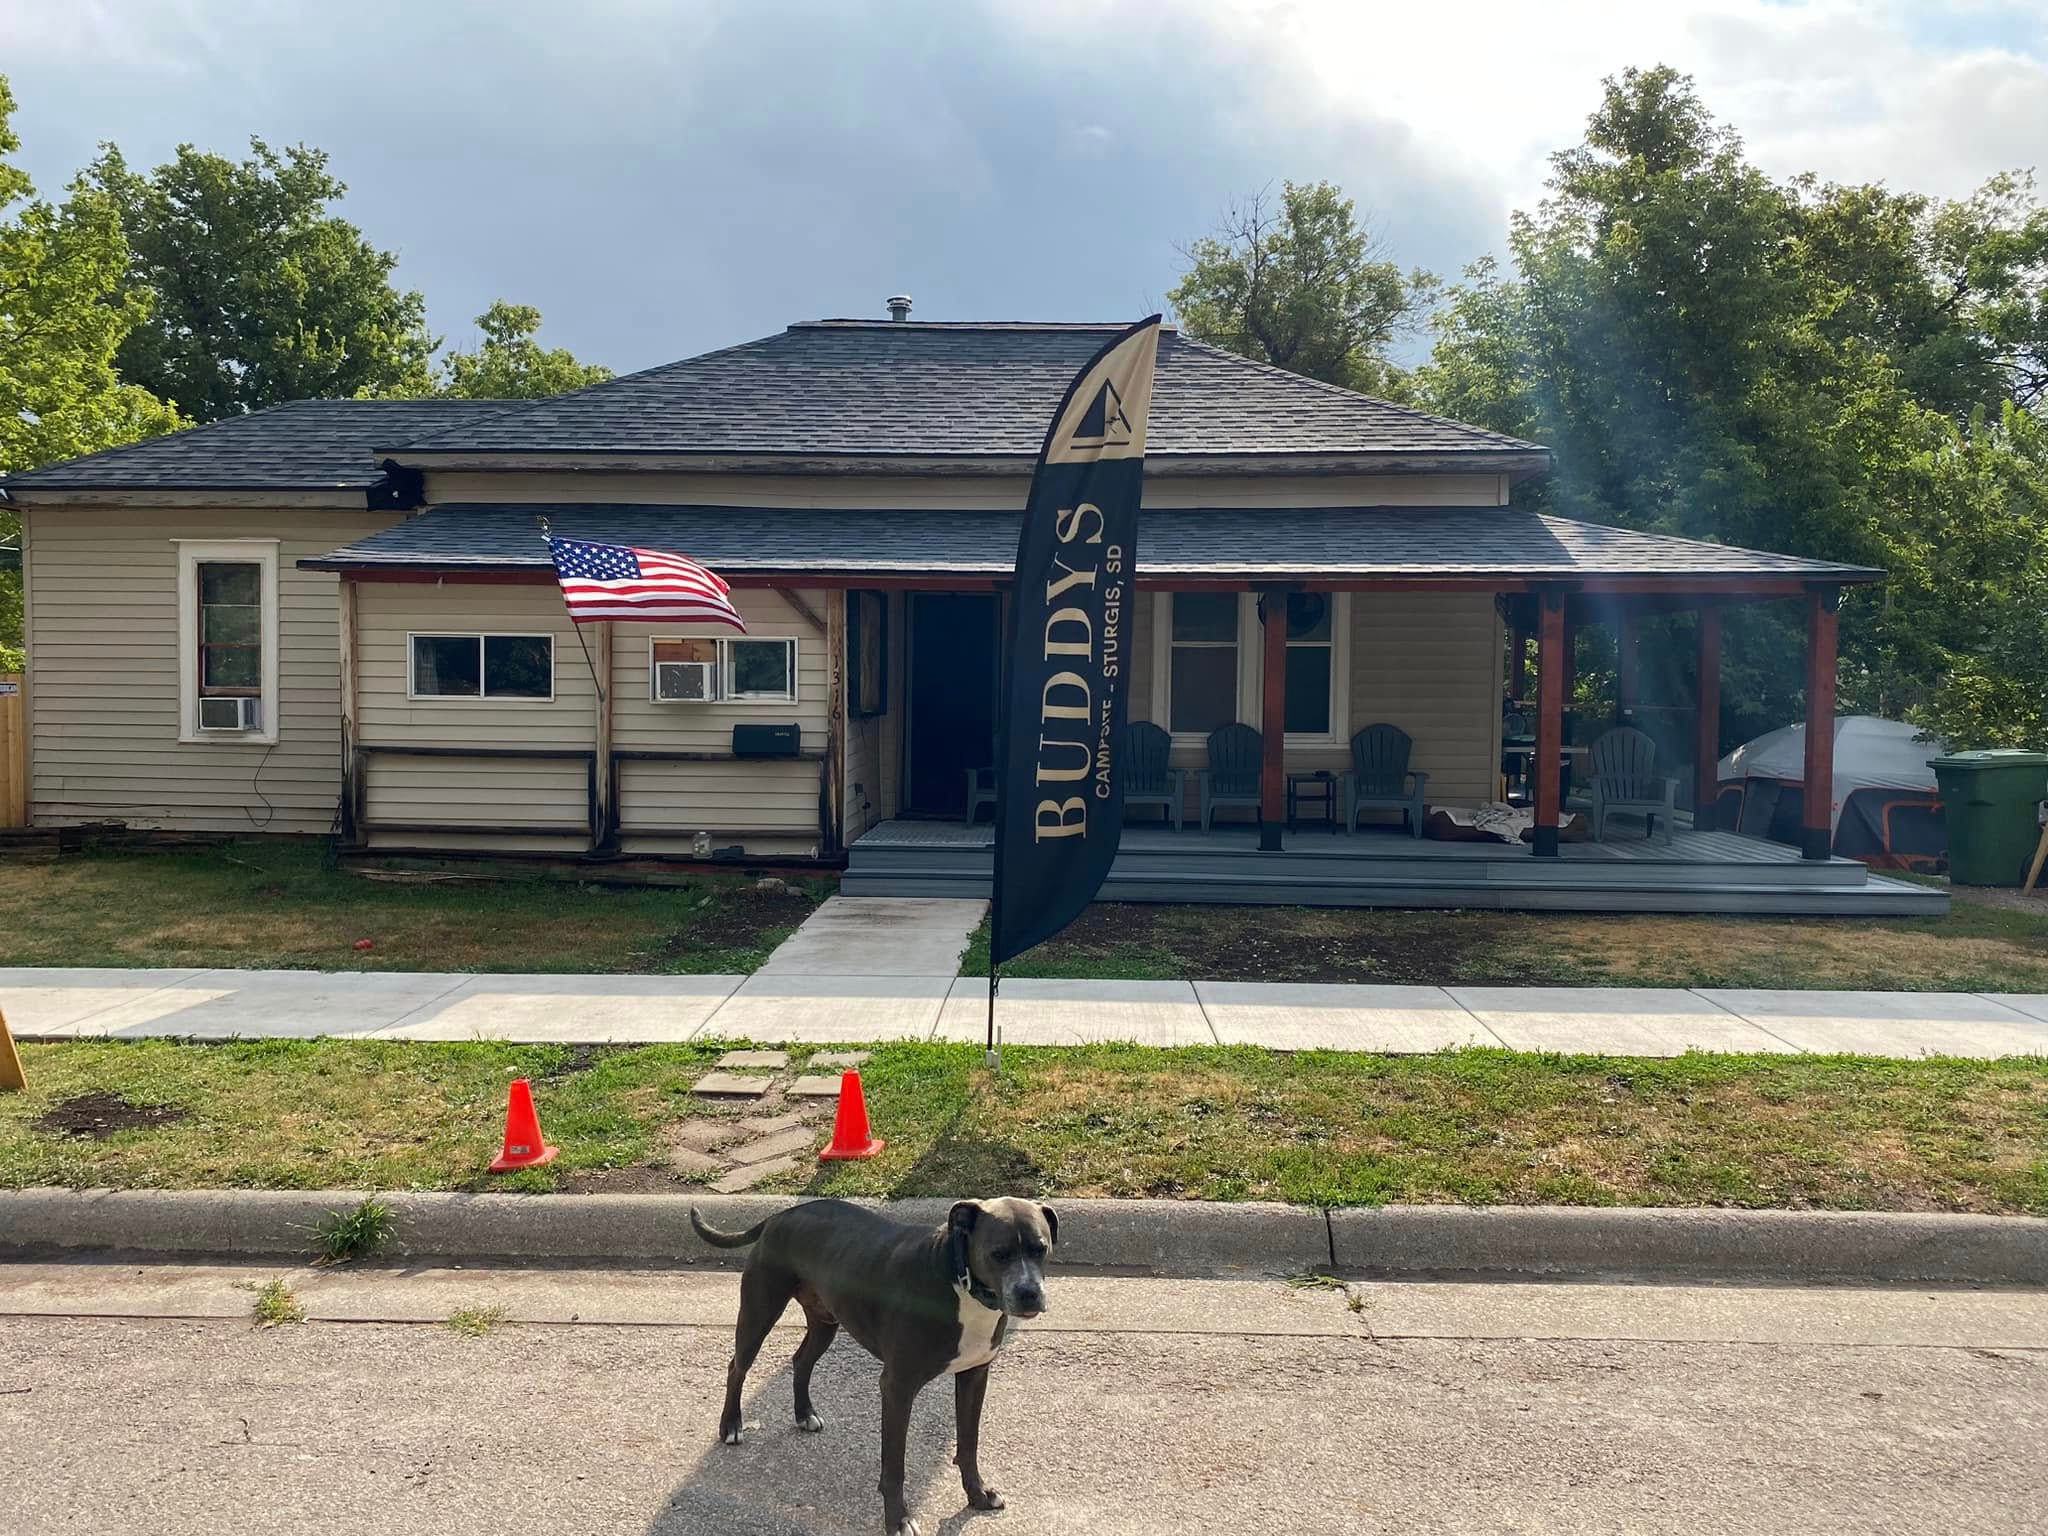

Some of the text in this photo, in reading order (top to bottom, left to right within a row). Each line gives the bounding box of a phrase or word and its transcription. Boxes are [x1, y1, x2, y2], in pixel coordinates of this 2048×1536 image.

[1106, 544, 1122, 574] SD
[1103, 580, 1124, 678] STURGIS,
[831, 655, 841, 721] 1316
[1035, 503, 1104, 844] BUDDYS
